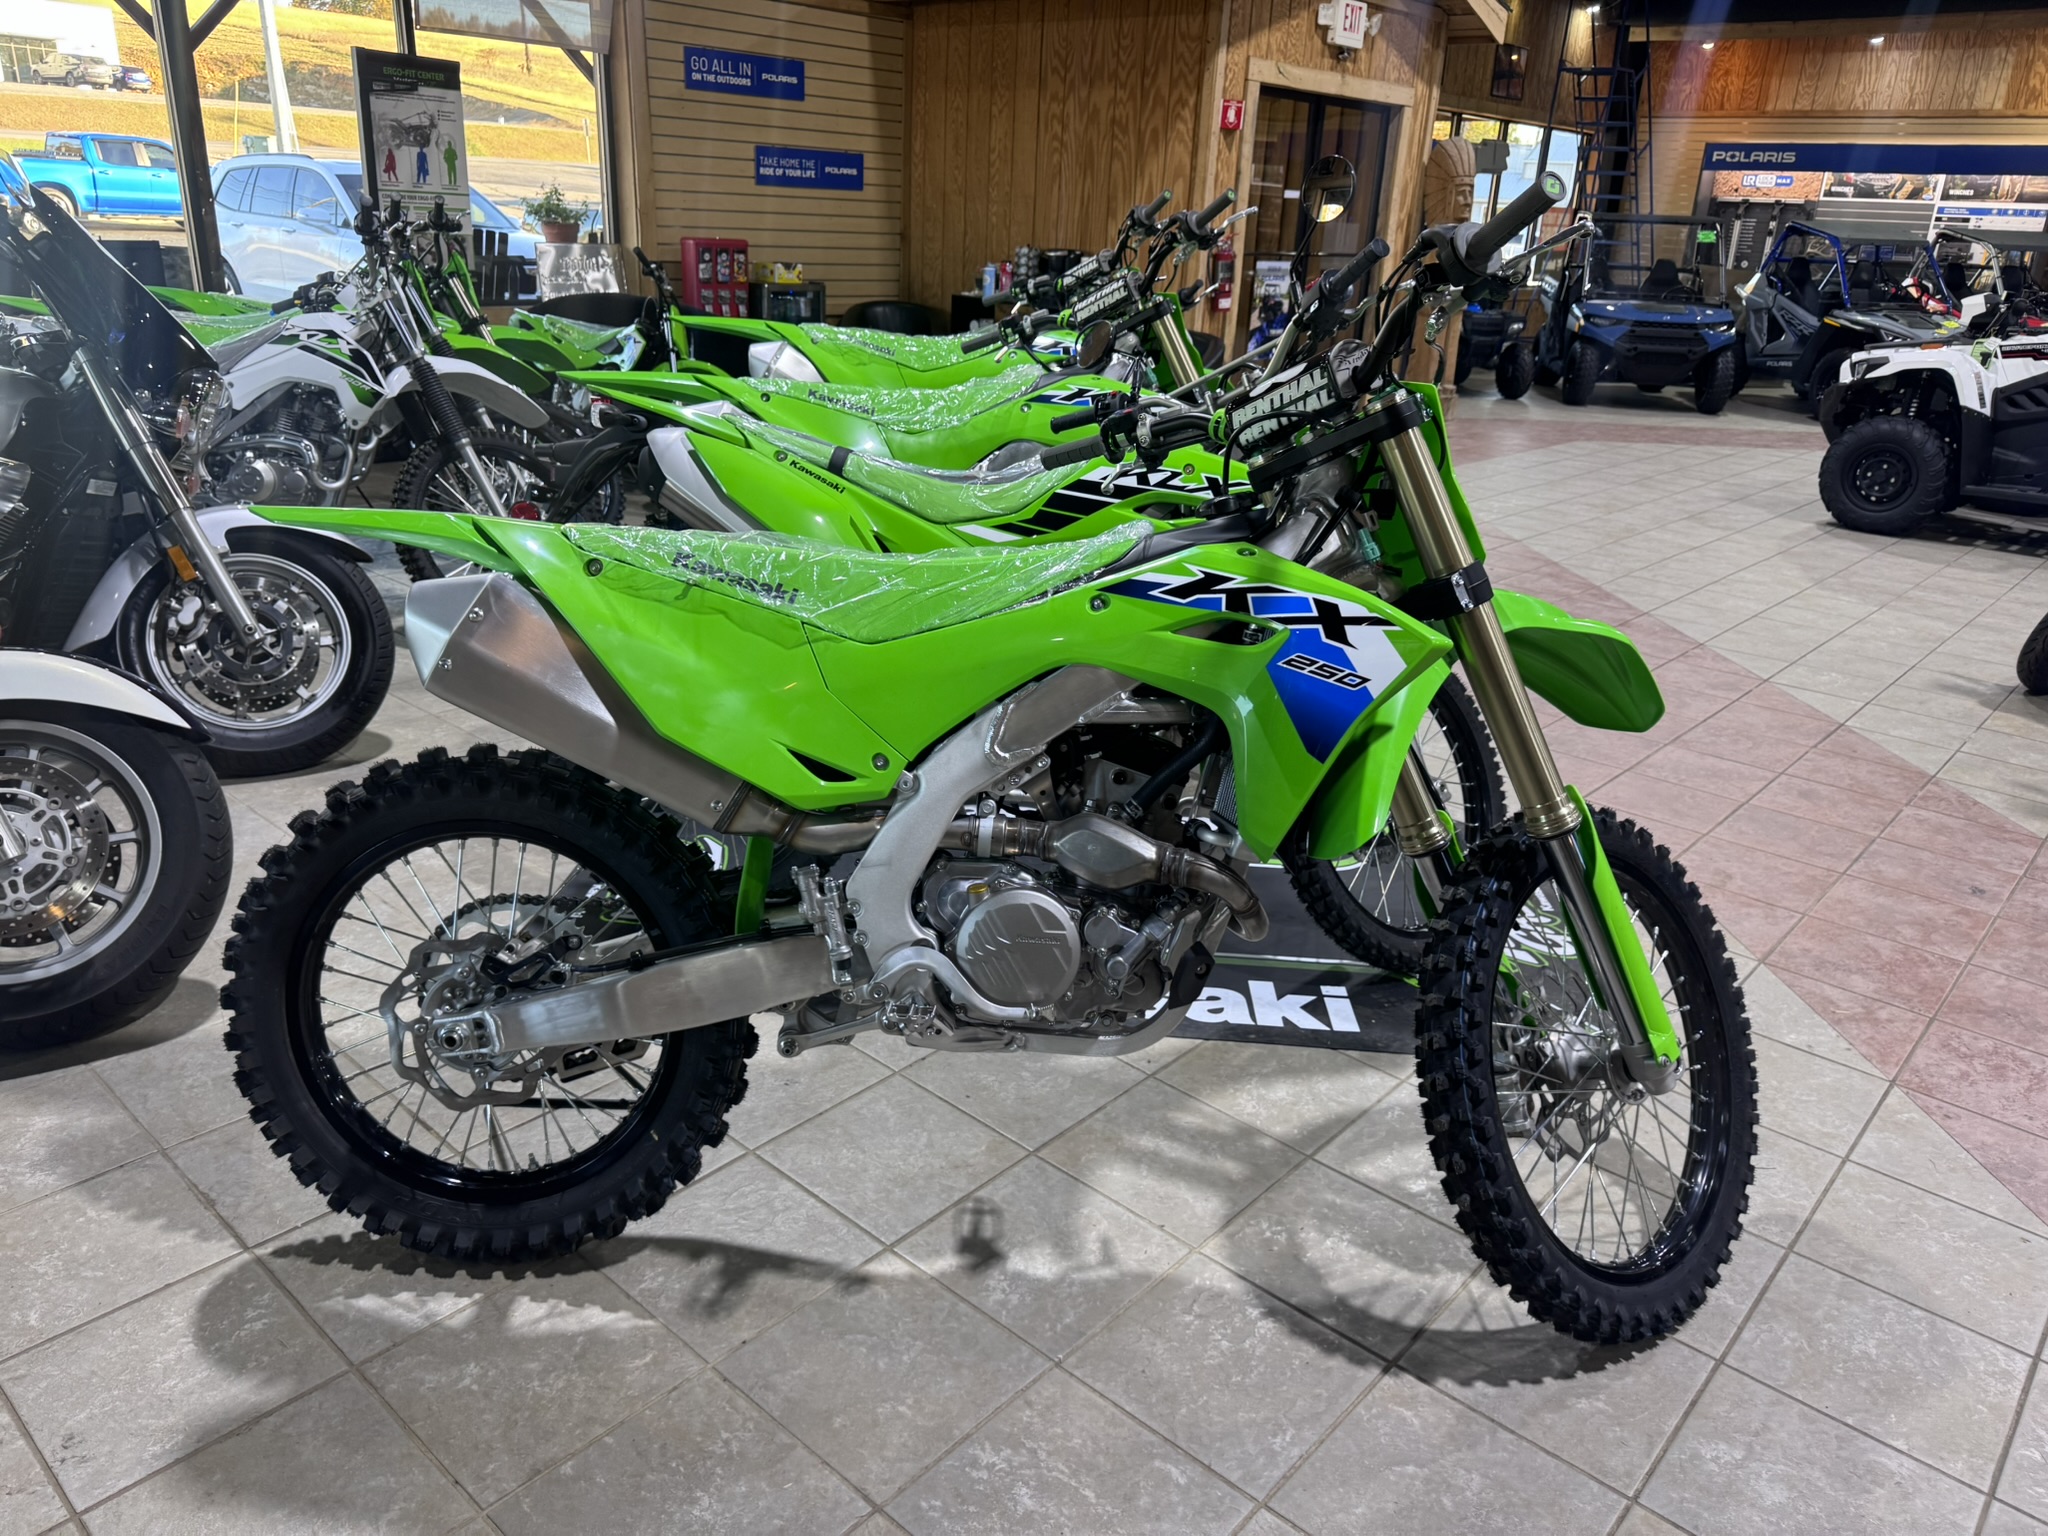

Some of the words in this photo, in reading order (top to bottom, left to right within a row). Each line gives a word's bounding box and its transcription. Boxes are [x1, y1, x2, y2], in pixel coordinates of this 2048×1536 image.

[1343, 3, 1363, 35] EXIT
[383, 66, 416, 78] ERGO-FIT
[417, 70, 445, 80] CENTER
[690, 56, 708, 71] GO
[711, 58, 736, 75] ALL
[739, 62, 752, 77] IN
[691, 72, 701, 80] ON
[703, 73, 716, 82] THE
[717, 76, 752, 87] OUTDOORS
[761, 73, 798, 84] POLARIS
[760, 156, 778, 167] TAKE
[780, 158, 800, 168] HOME
[802, 160, 816, 169] THE
[1712, 151, 1796, 163] POLARIS
[759, 167, 774, 175] RIDE
[775, 168, 784, 176] OF
[785, 169, 801, 178] YOUR
[802, 170, 816, 178] LIFE
[824, 166, 858, 176] POLARIS
[807, 388, 876, 417] Kawasaki
[1232, 368, 1328, 430] RENTHAL
[789, 459, 846, 494] Kawasaki
[1148, 564, 1404, 651] KX
[1279, 653, 1372, 690] 250
[1184, 979, 1361, 1033] aki
